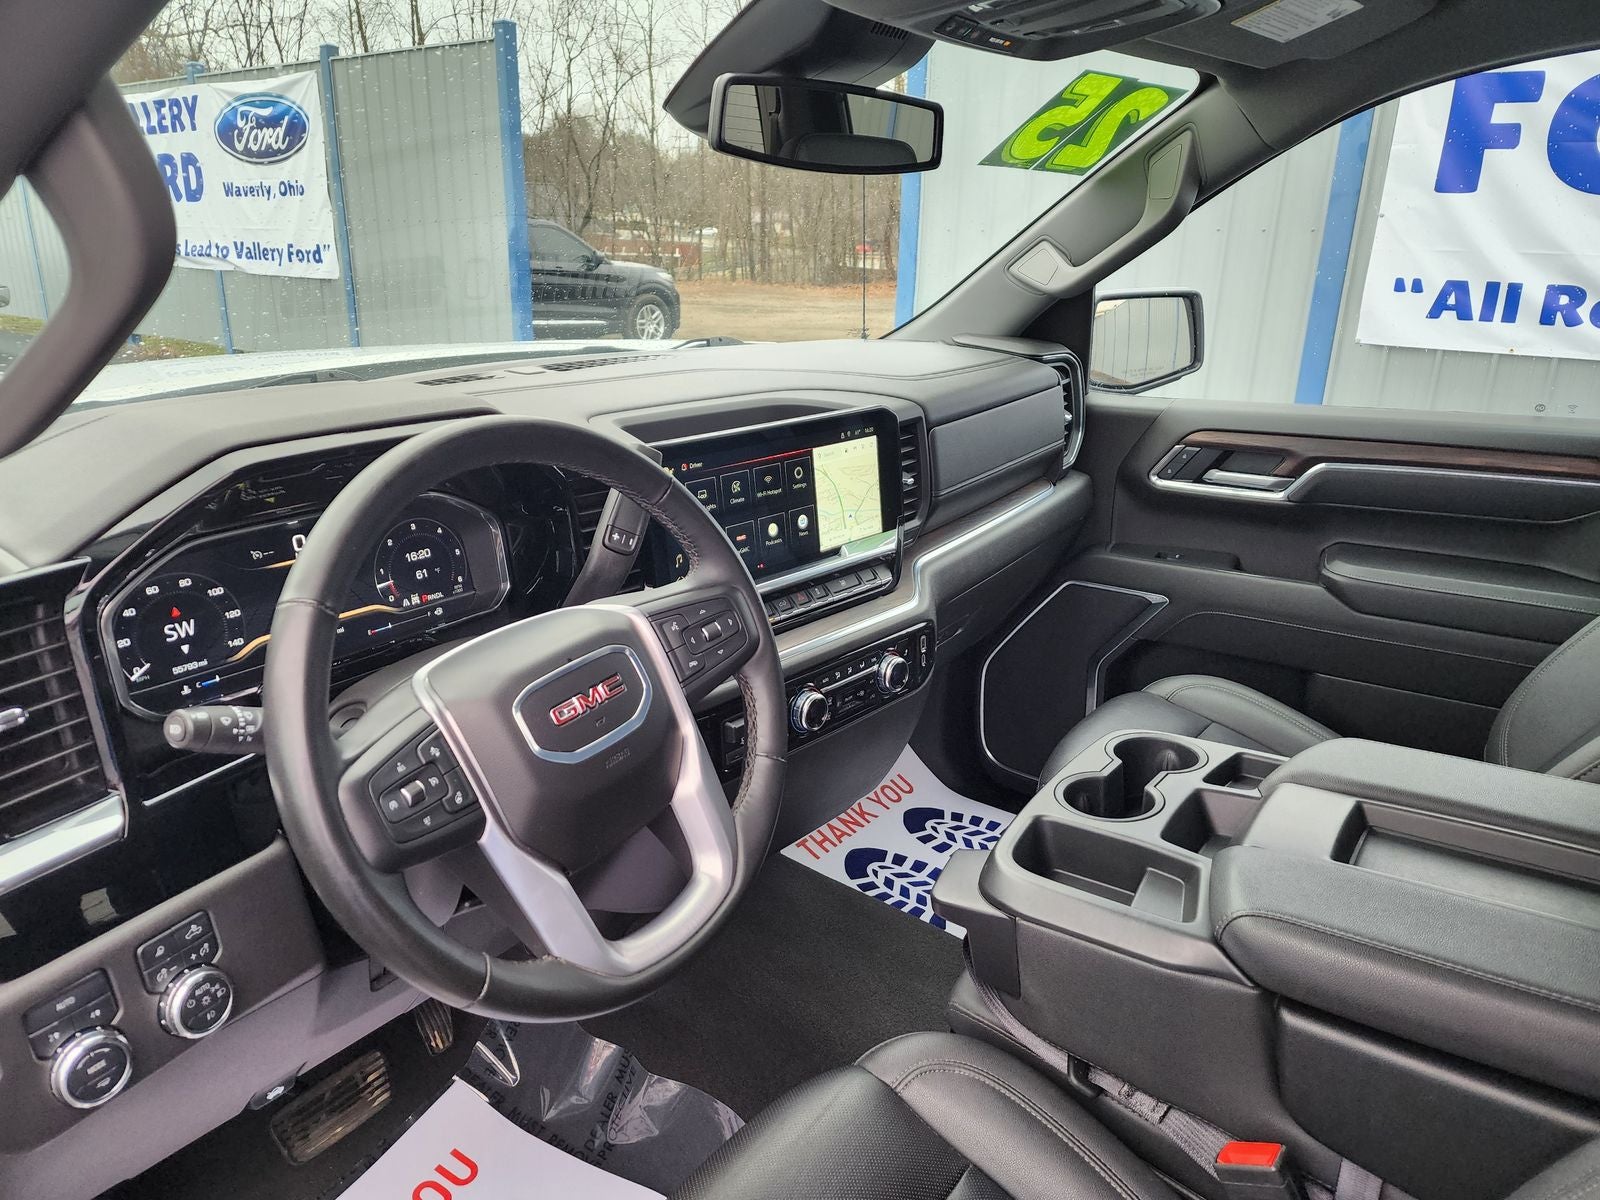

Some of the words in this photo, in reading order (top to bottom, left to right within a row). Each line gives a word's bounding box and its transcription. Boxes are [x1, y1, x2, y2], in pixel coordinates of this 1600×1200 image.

[233, 105, 289, 152] Ford
[278, 180, 305, 197] Ohio
[184, 239, 213, 257] Lead
[215, 242, 230, 259] to
[233, 240, 284, 267] Vallery
[729, 497, 745, 505] Climate
[405, 548, 431, 562] 16:20
[455, 548, 460, 556] 5
[415, 568, 428, 580] 61
[178, 578, 192, 588] 80
[145, 586, 160, 595] 60
[207, 587, 224, 596] 100
[122, 608, 136, 617] 40
[224, 609, 241, 619] 120
[163, 619, 195, 642] SW
[116, 638, 131, 648] 20
[227, 637, 244, 648] 140
[549, 672, 628, 727] GMC
[795, 802, 880, 860] THANK
[866, 773, 914, 810] YOU
[194, 982, 211, 996] AUTO
